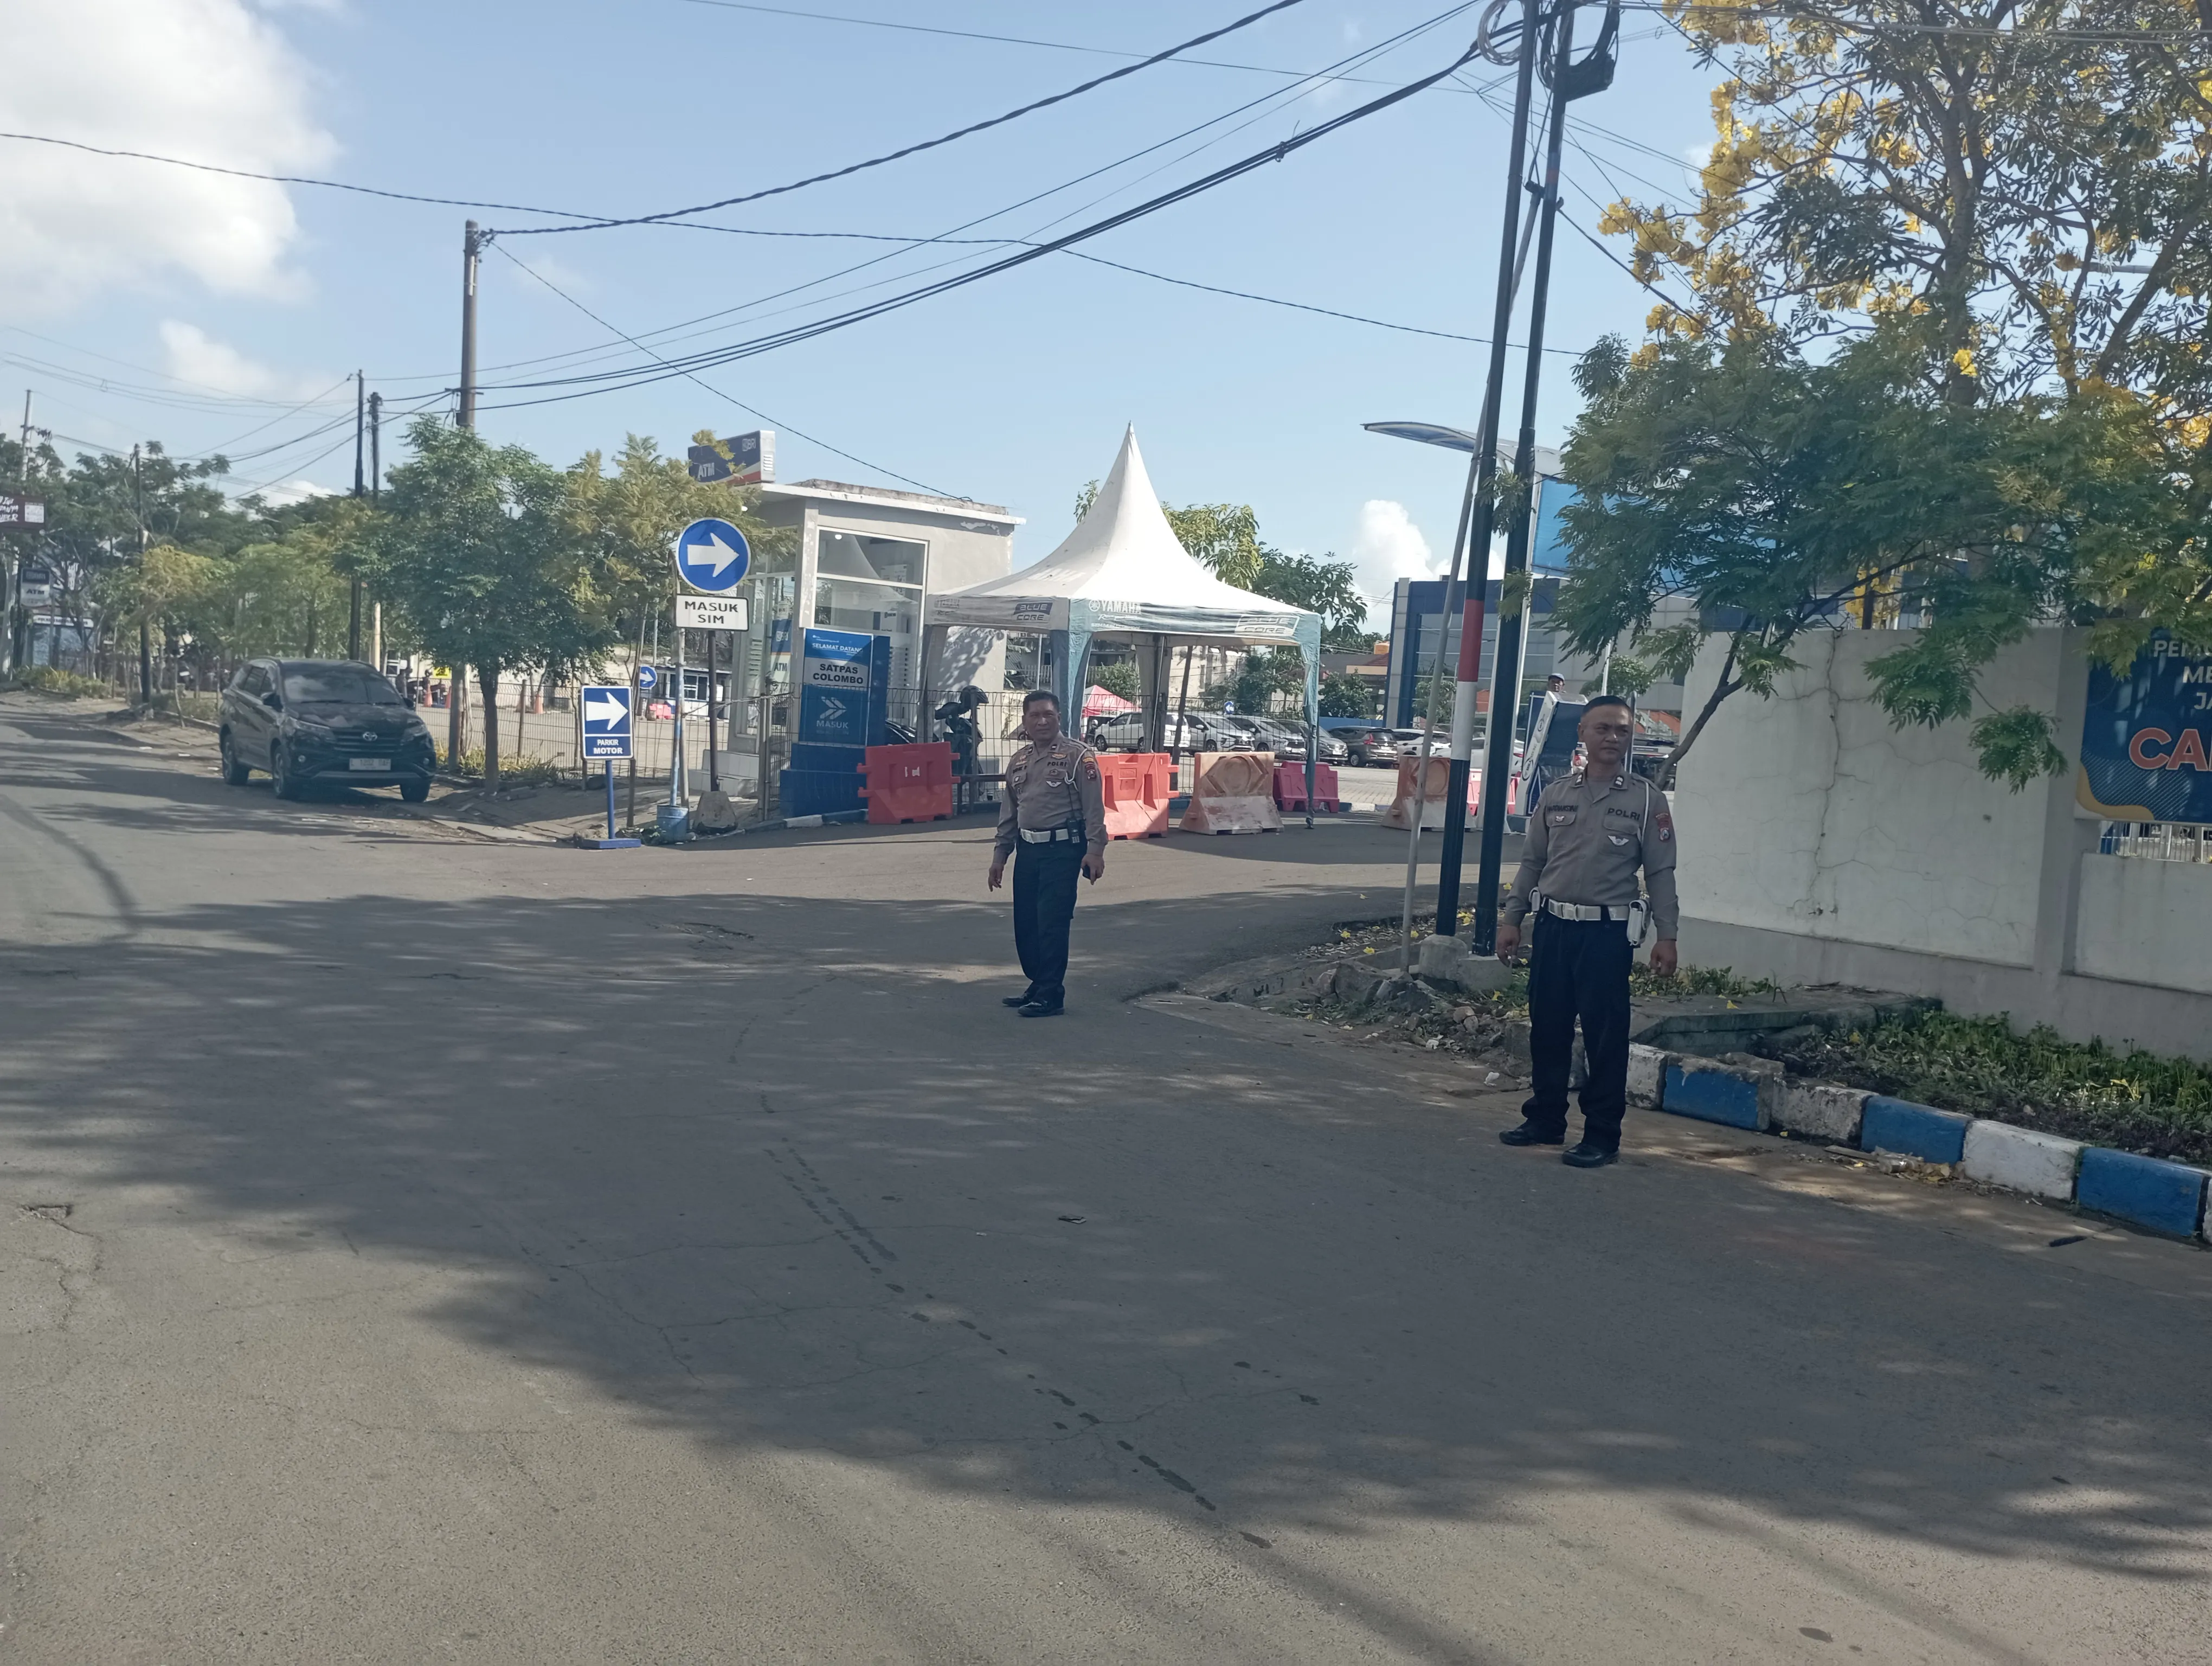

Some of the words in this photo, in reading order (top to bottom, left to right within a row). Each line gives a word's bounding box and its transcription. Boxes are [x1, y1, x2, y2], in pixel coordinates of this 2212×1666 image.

[697, 462, 715, 481] ATM
[685, 601, 738, 612] MASUK
[1101, 599, 1142, 614] YAMAHA
[698, 614, 724, 624] SIM
[812, 643, 839, 651] SELAMAT
[774, 662, 787, 671] ATM
[820, 663, 858, 674] SATPAS
[813, 672, 864, 684] COLOMBO
[816, 720, 848, 729] MASUK
[2129, 727, 2212, 771] CA
[1607, 808, 1640, 820] POLRI
